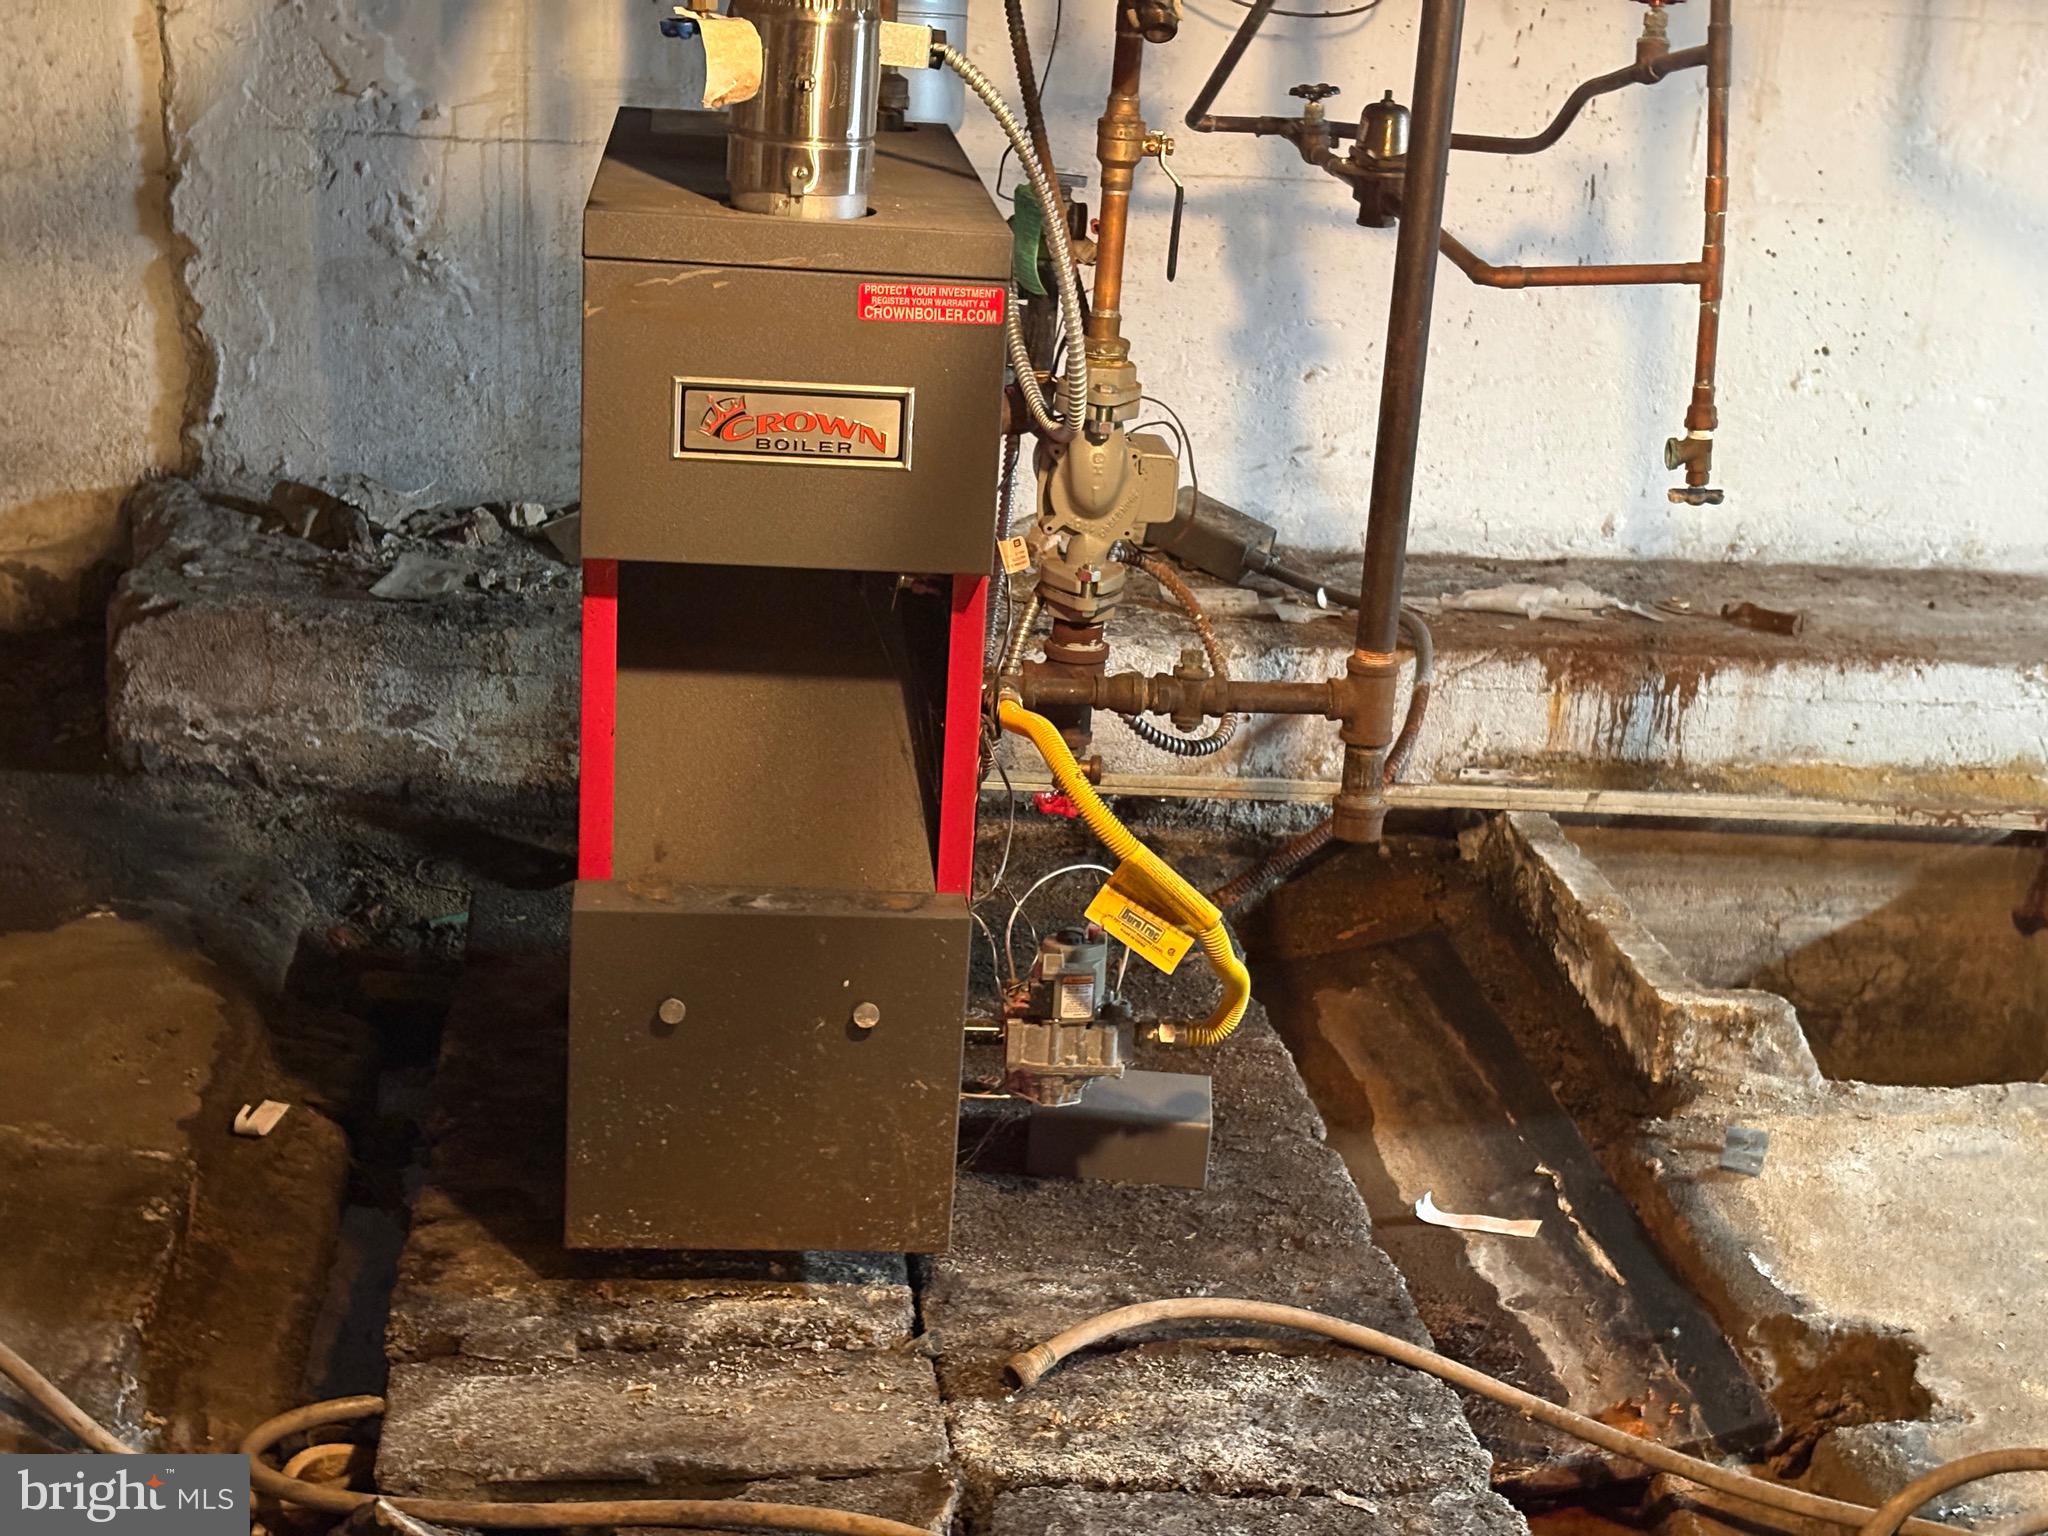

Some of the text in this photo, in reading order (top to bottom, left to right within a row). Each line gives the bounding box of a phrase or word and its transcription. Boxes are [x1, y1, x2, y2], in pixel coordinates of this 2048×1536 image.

[864, 284, 998, 298] PROTECT YOUR INVESTMENT
[871, 296, 989, 308] REGISTER YOUR WARRANTY AT
[864, 305, 997, 323] CROWNBOILER.COM
[721, 410, 888, 454] CROWN
[755, 438, 853, 454] BOILER
